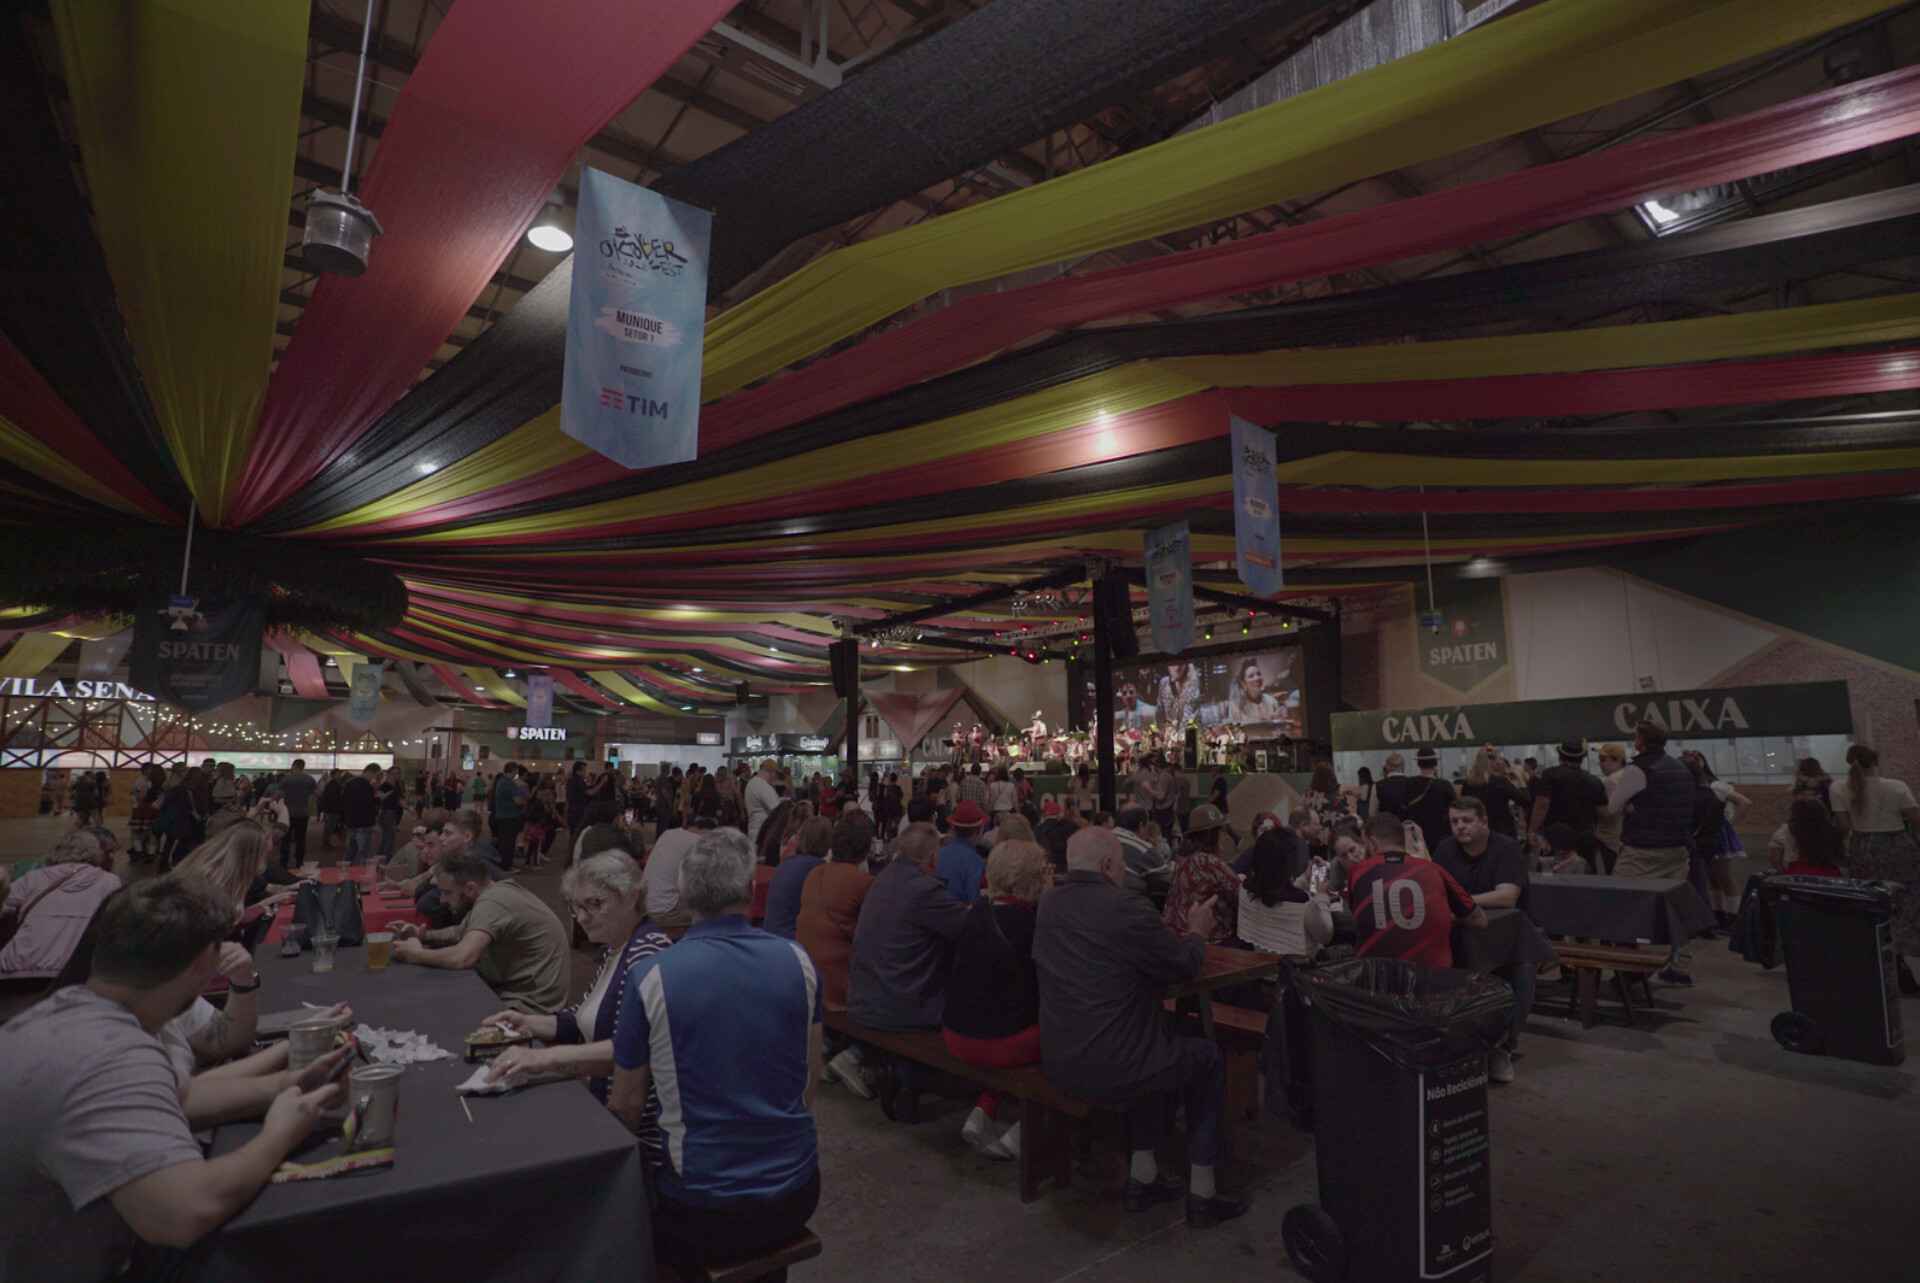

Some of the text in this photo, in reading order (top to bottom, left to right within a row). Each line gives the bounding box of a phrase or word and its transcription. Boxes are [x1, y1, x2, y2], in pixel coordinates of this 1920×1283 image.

[616, 310, 664, 335] MUNIQUE
[626, 395, 669, 419] TIM
[158, 641, 240, 661] SPATEN
[1429, 641, 1497, 666] SPATEN
[1382, 711, 1475, 744] CAIXA
[1614, 696, 1749, 734] CAIXA
[519, 727, 566, 741] SPATEN
[1371, 878, 1425, 931] 10
